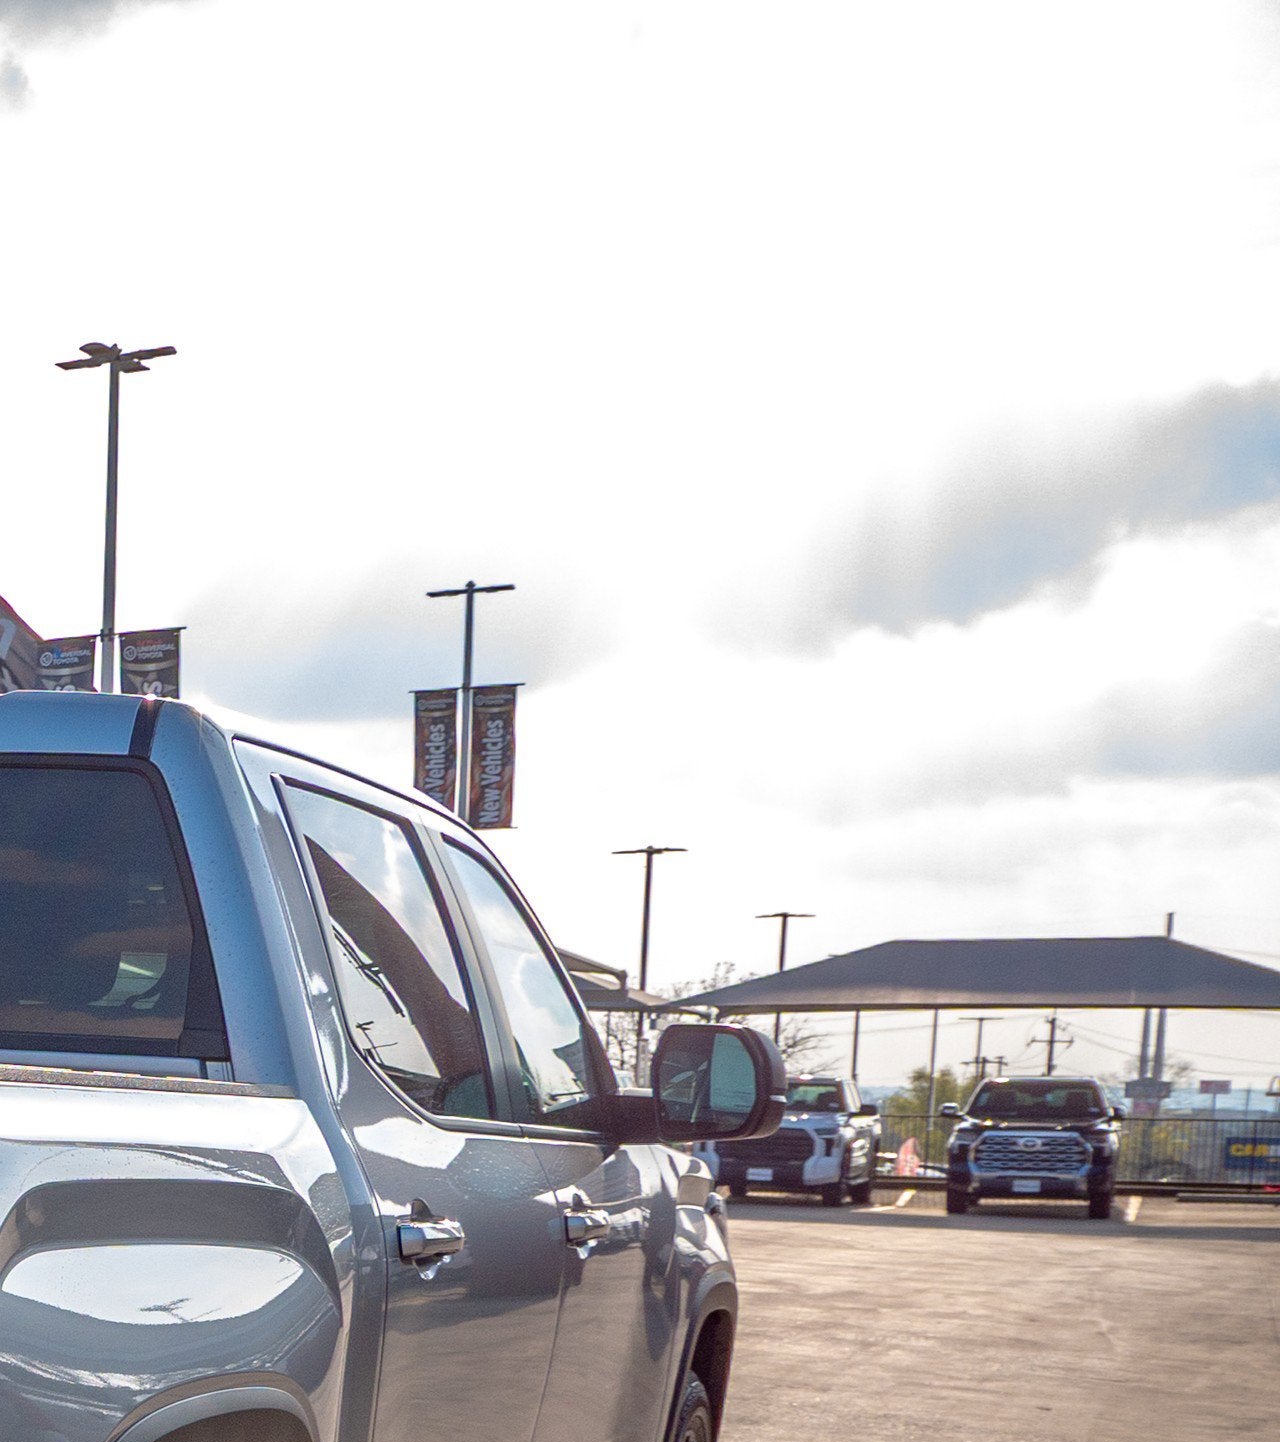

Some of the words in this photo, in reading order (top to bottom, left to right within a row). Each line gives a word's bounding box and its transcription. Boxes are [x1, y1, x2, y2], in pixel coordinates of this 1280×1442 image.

[424, 723, 446, 790] Vehicles
[481, 720, 504, 786] Vehicles
[479, 788, 500, 823] New
